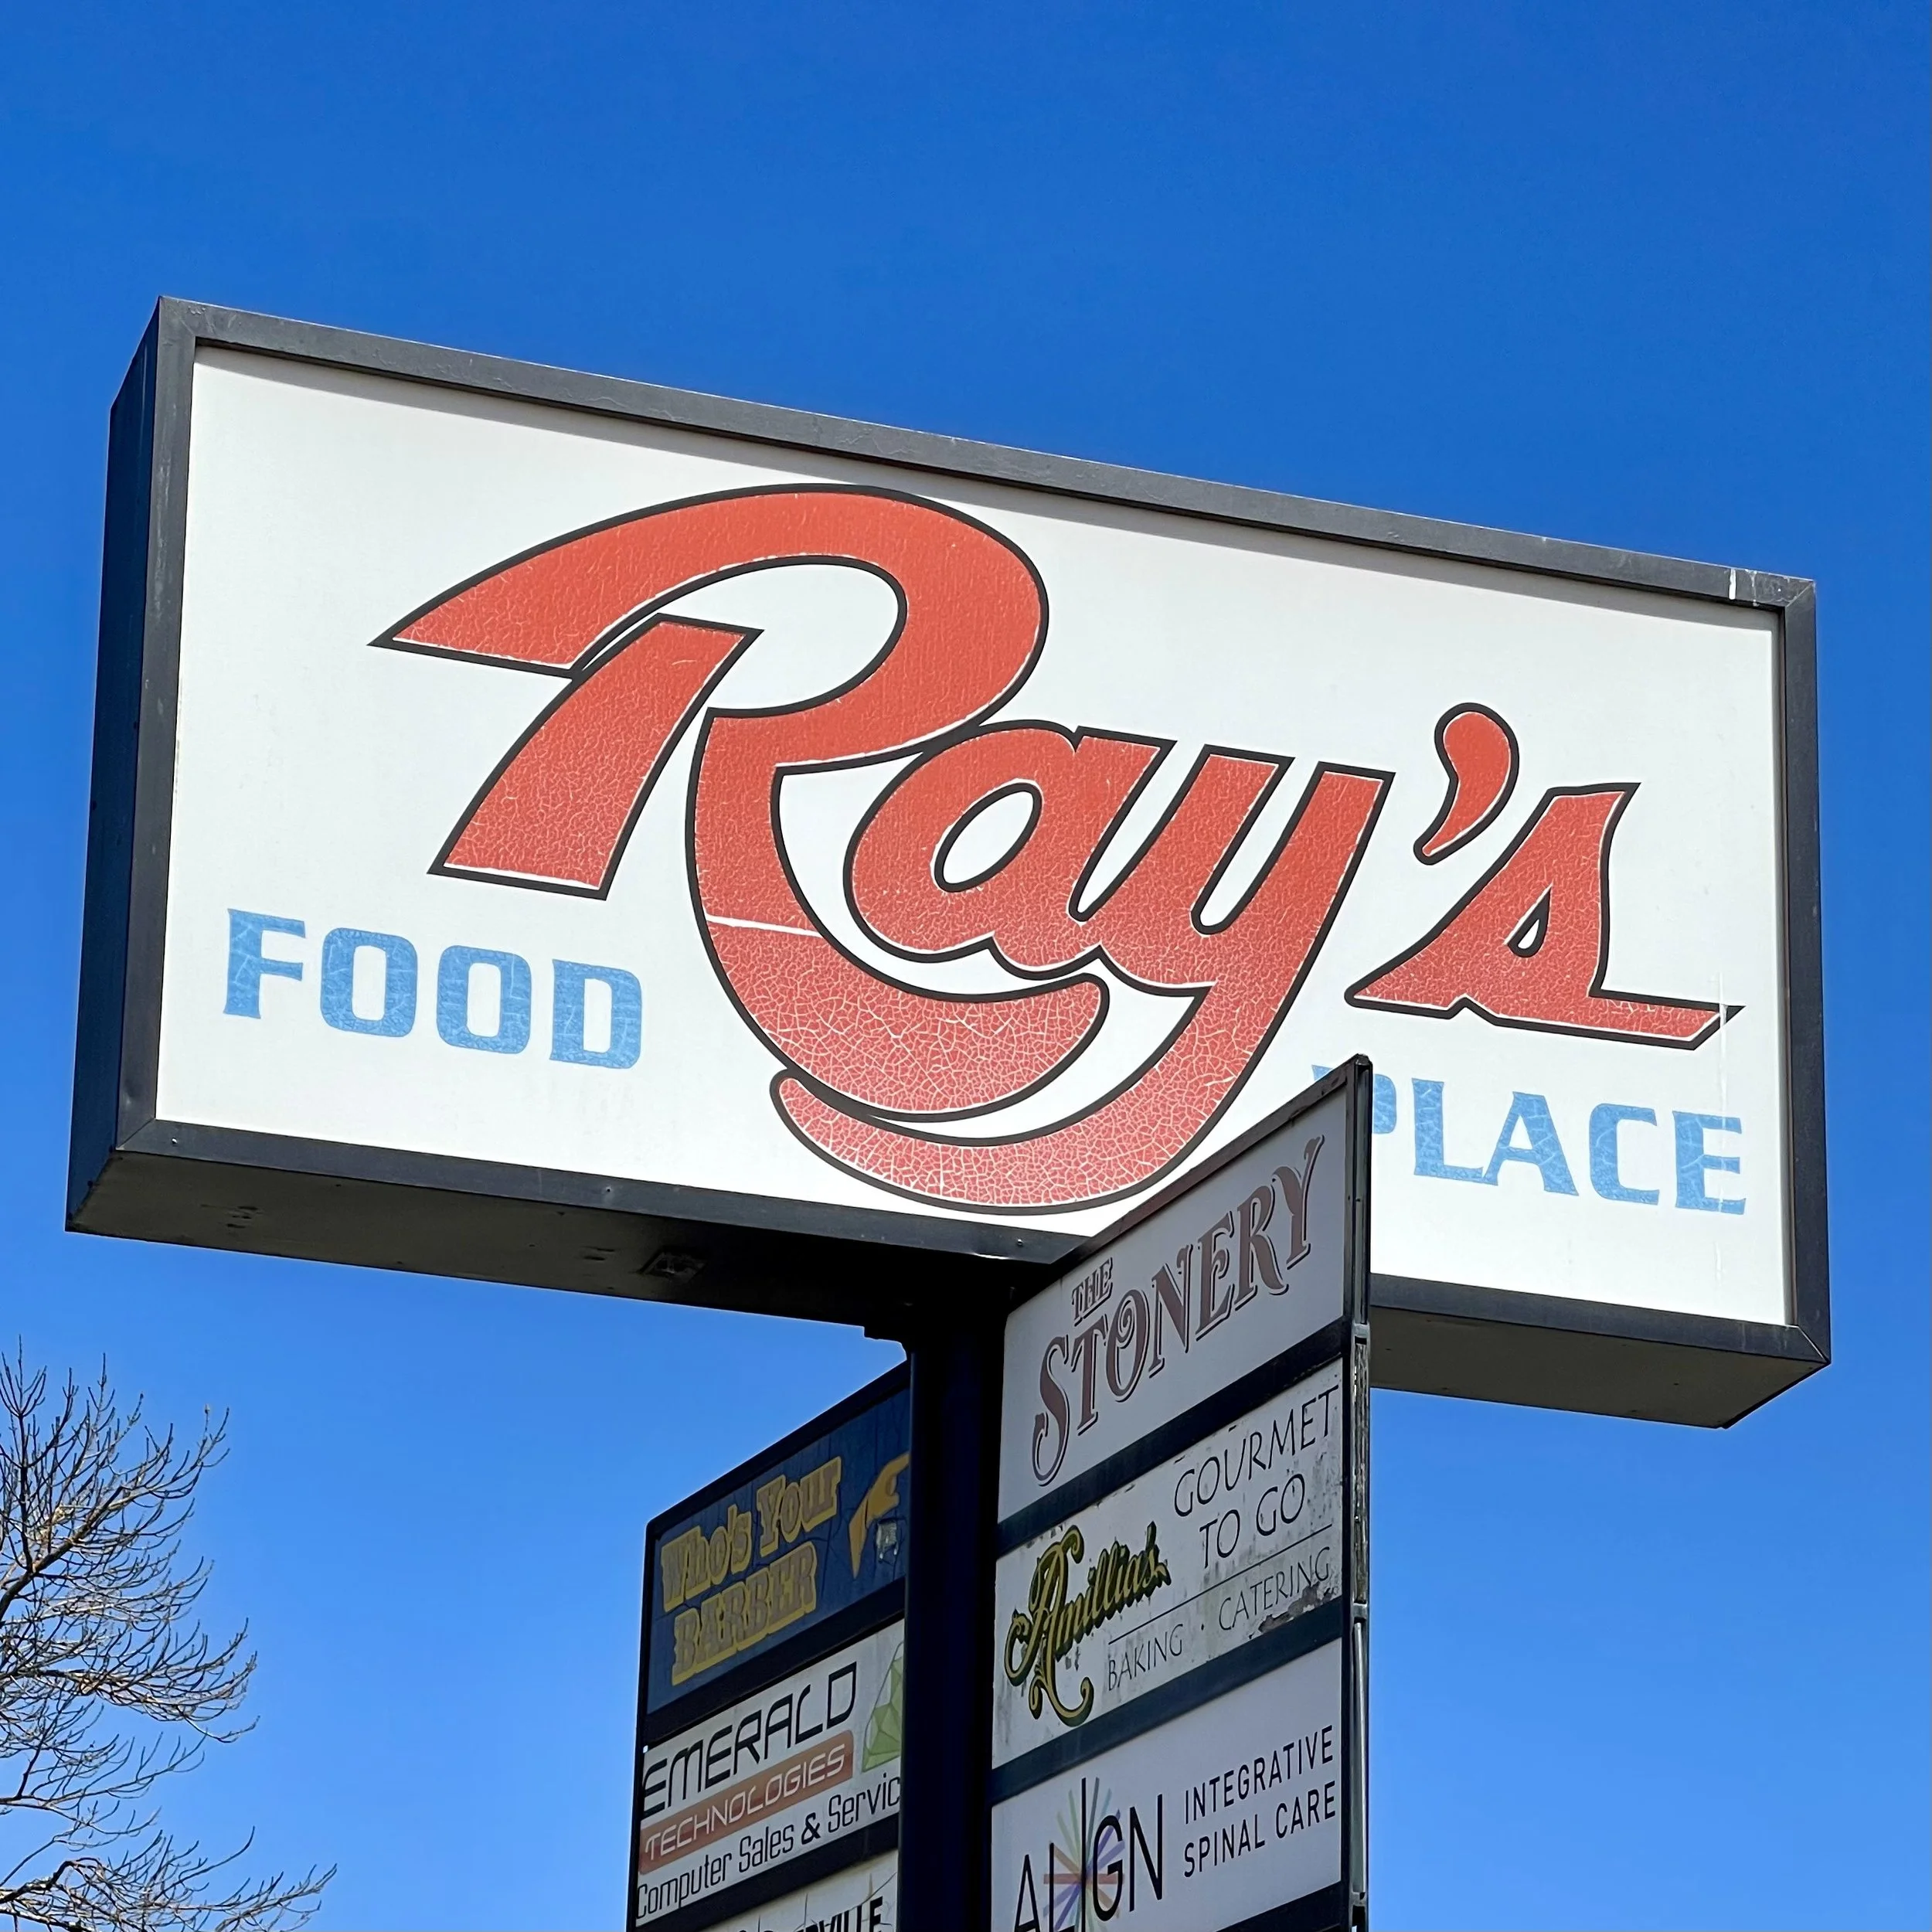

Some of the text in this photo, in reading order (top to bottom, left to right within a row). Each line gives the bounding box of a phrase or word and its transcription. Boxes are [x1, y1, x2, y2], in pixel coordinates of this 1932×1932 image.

[368, 483, 1744, 1214] Ray's
[223, 908, 642, 1070] FOOD
[1031, 1134, 1325, 1487] STONERY
[1071, 1257, 1113, 1326] THE
[1173, 1385, 1339, 1517] GOURMET
[1199, 1473, 1305, 1570] TO GO
[661, 1456, 842, 1613] Who's Your
[672, 1541, 818, 1686] BARBER
[1108, 1546, 1332, 1692] BAKING CATERING
[644, 1662, 857, 1818] EMERALD
[645, 1743, 845, 1861] TECHNOLOGIES
[1185, 1724, 1334, 1825] INTEGRATIVE
[636, 1855, 732, 1920] Computer
[738, 1825, 794, 1873] Sales
[801, 1812, 821, 1845] &
[1014, 1777, 1163, 1932] ALIGN
[1183, 1780, 1337, 1879] SPINAL CARE
